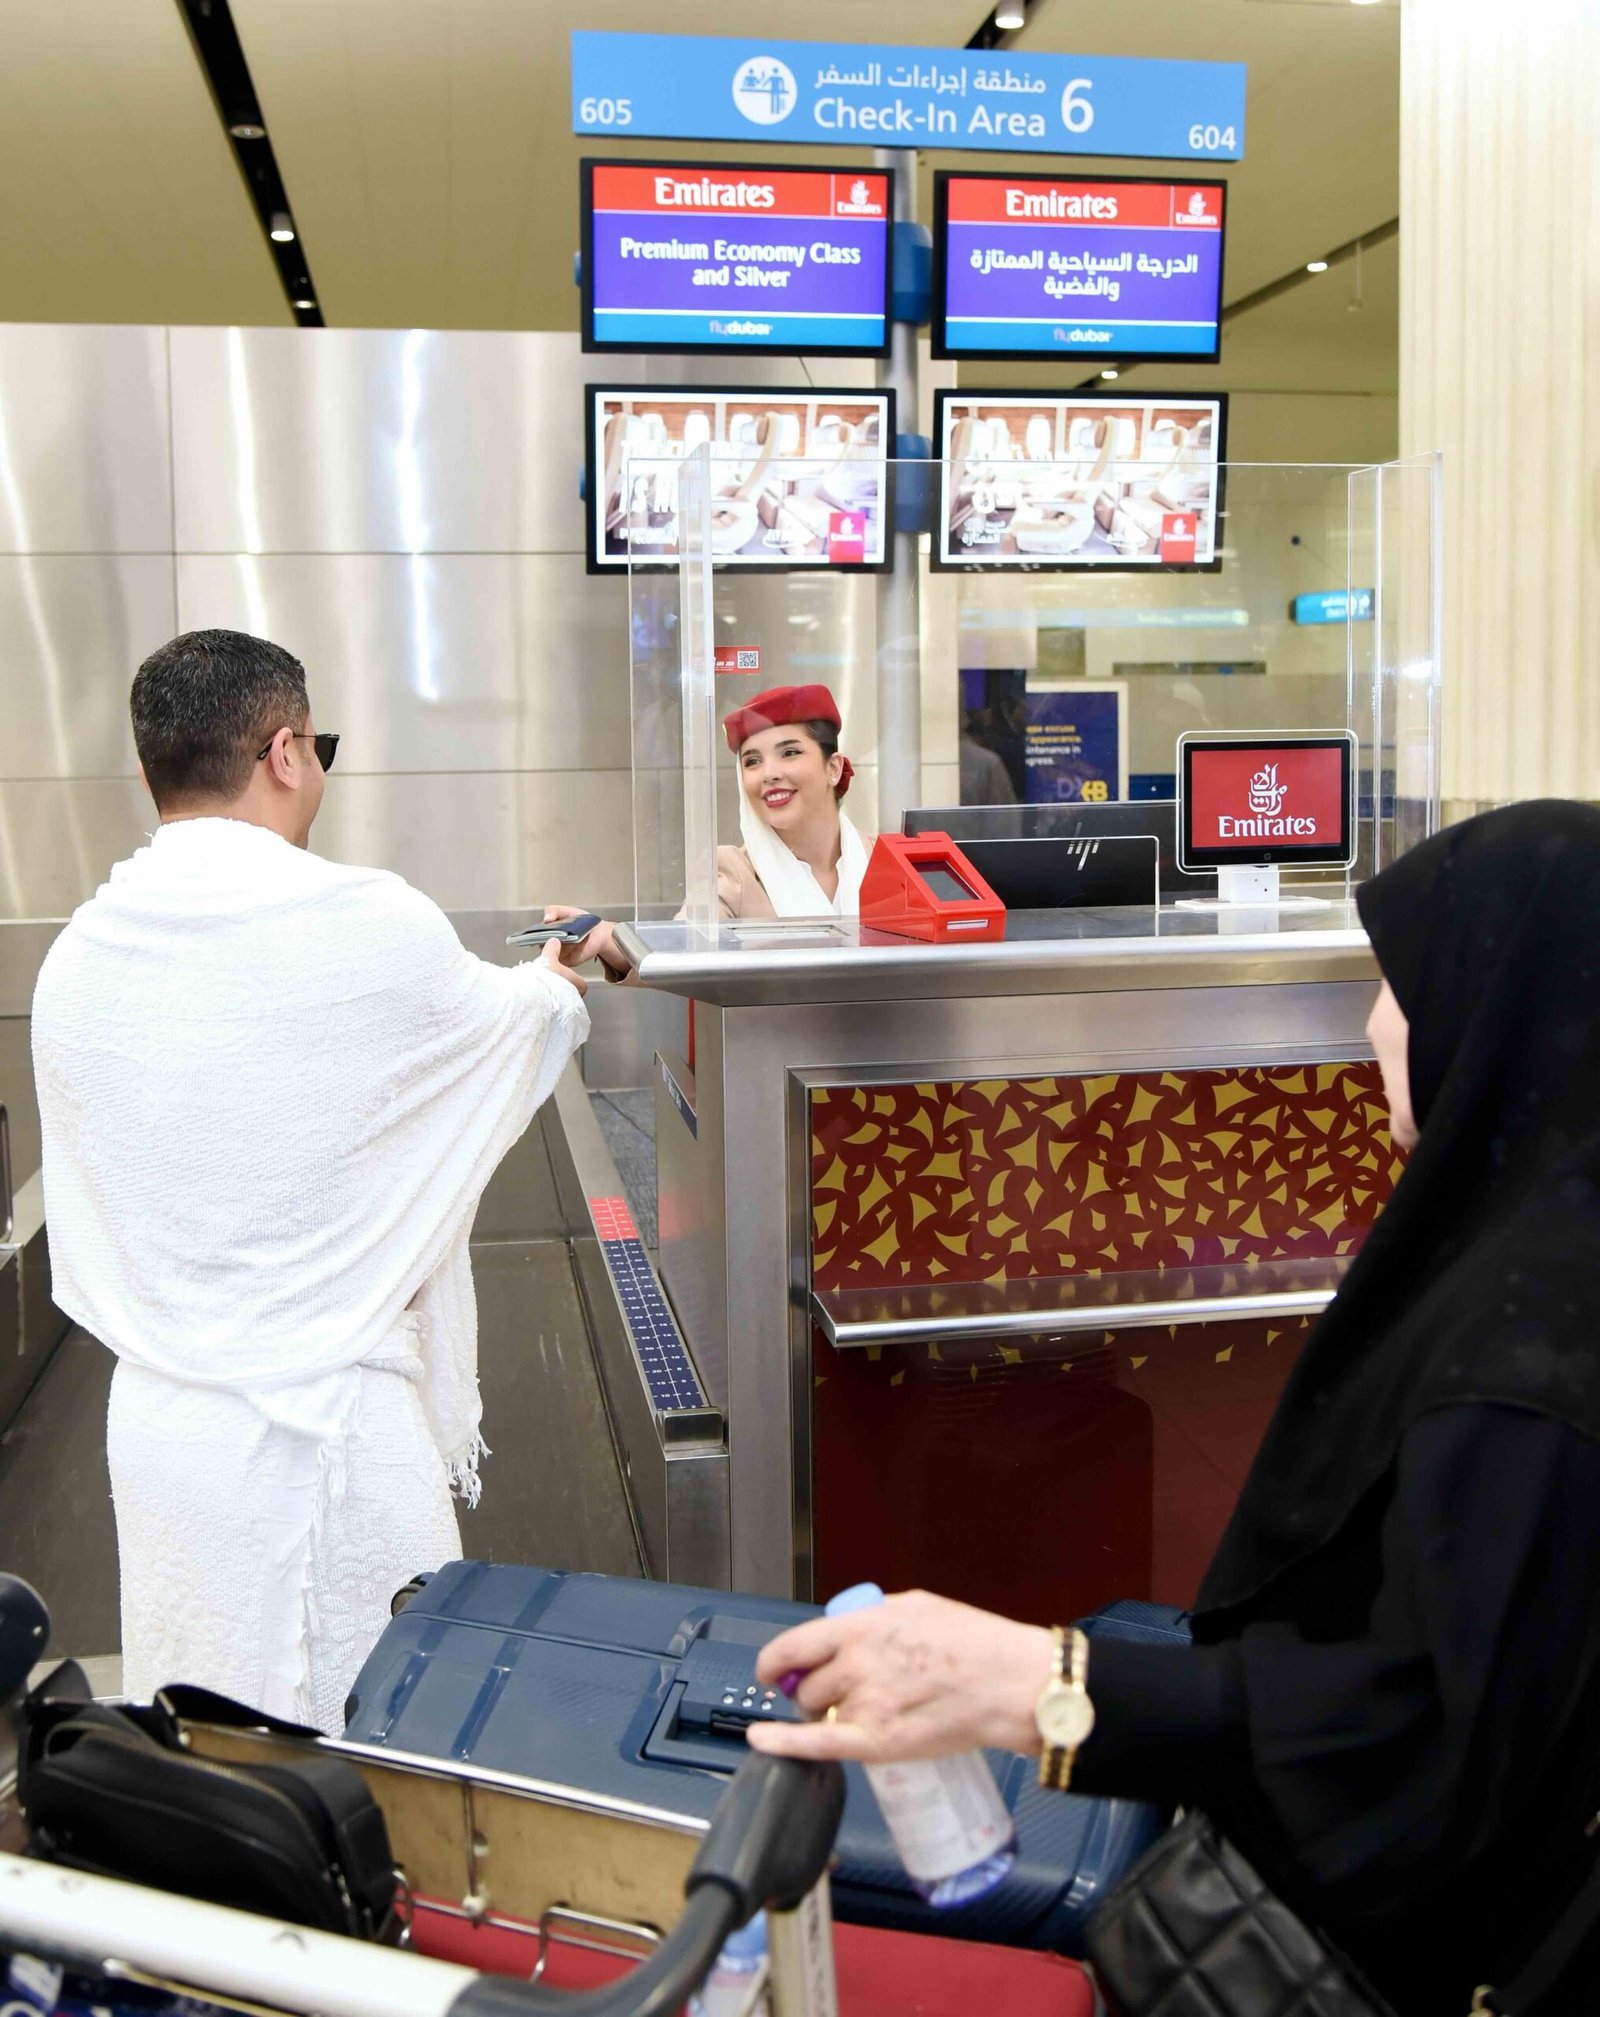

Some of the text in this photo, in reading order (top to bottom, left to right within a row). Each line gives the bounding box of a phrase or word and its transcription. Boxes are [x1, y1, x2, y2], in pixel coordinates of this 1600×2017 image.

[814, 63, 1046, 97] منطقة إجراءات السفر
[579, 97, 632, 126] 605
[813, 97, 1046, 137] Check-In Area
[1061, 78, 1095, 133] 6
[1188, 124, 1236, 151] 604
[654, 177, 775, 207] Emirates
[1005, 189, 1118, 219] Emirates
[620, 237, 861, 268] Premium Economy Class
[970, 249, 1198, 278] الدرجة السياحية الممتازة
[692, 265, 791, 288] and Silver
[1044, 276, 1120, 302] والفضية
[1218, 814, 1316, 838] Emirates
